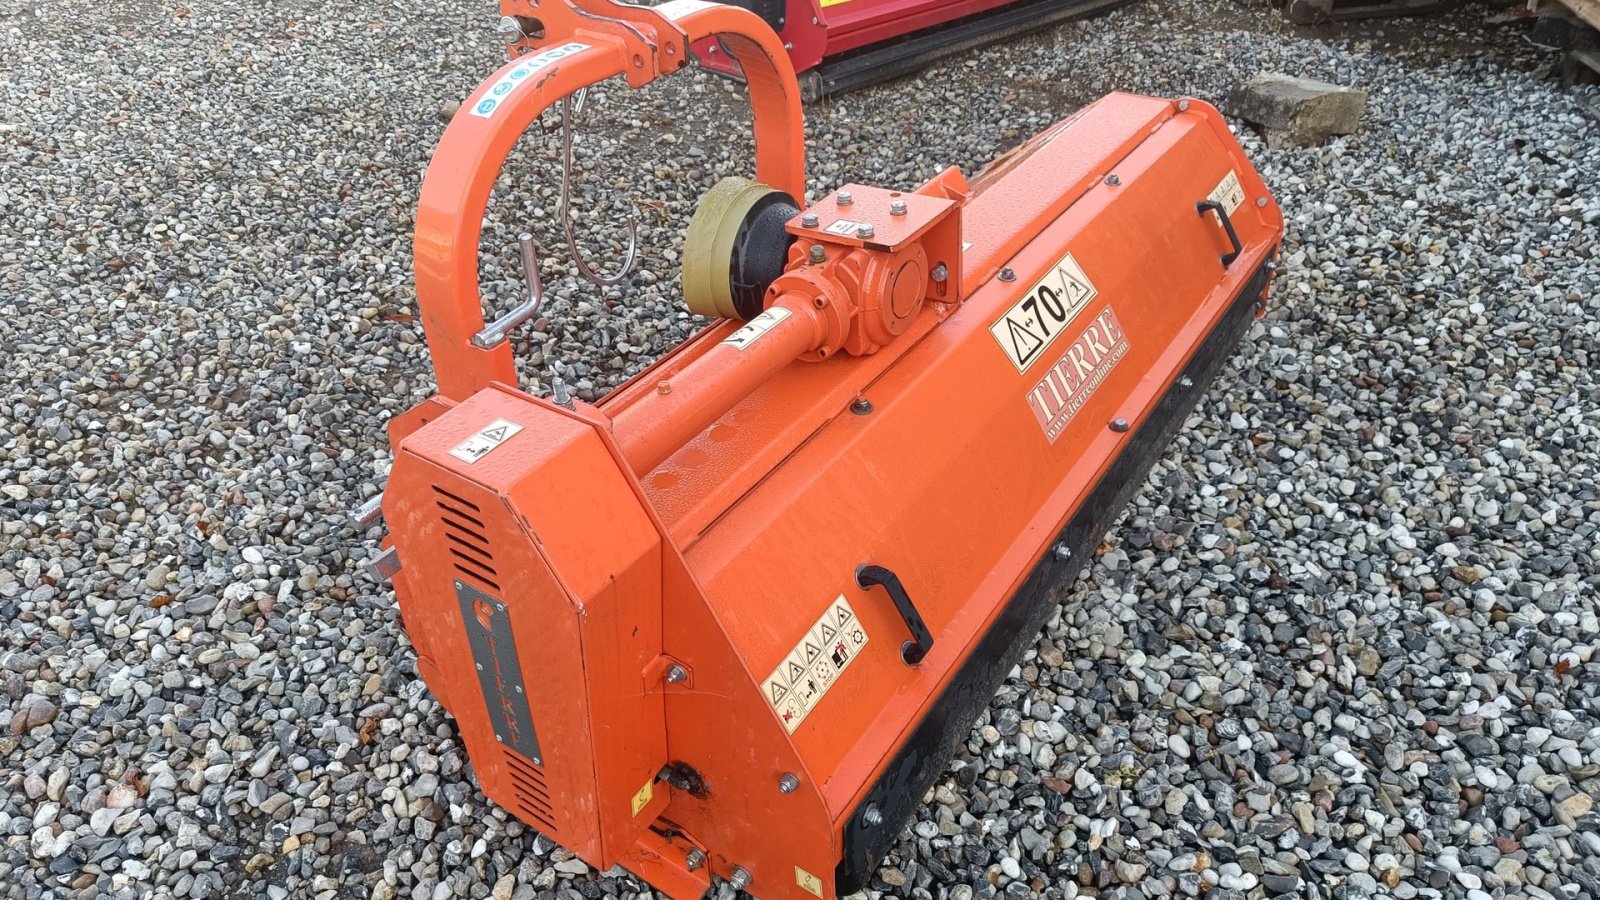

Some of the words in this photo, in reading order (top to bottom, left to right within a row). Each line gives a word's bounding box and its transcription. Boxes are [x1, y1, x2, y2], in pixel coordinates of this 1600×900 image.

[1021, 285, 1066, 337] 70
[1028, 309, 1122, 426] TIERRE
[1047, 340, 1128, 440] www.tierreonline.com
